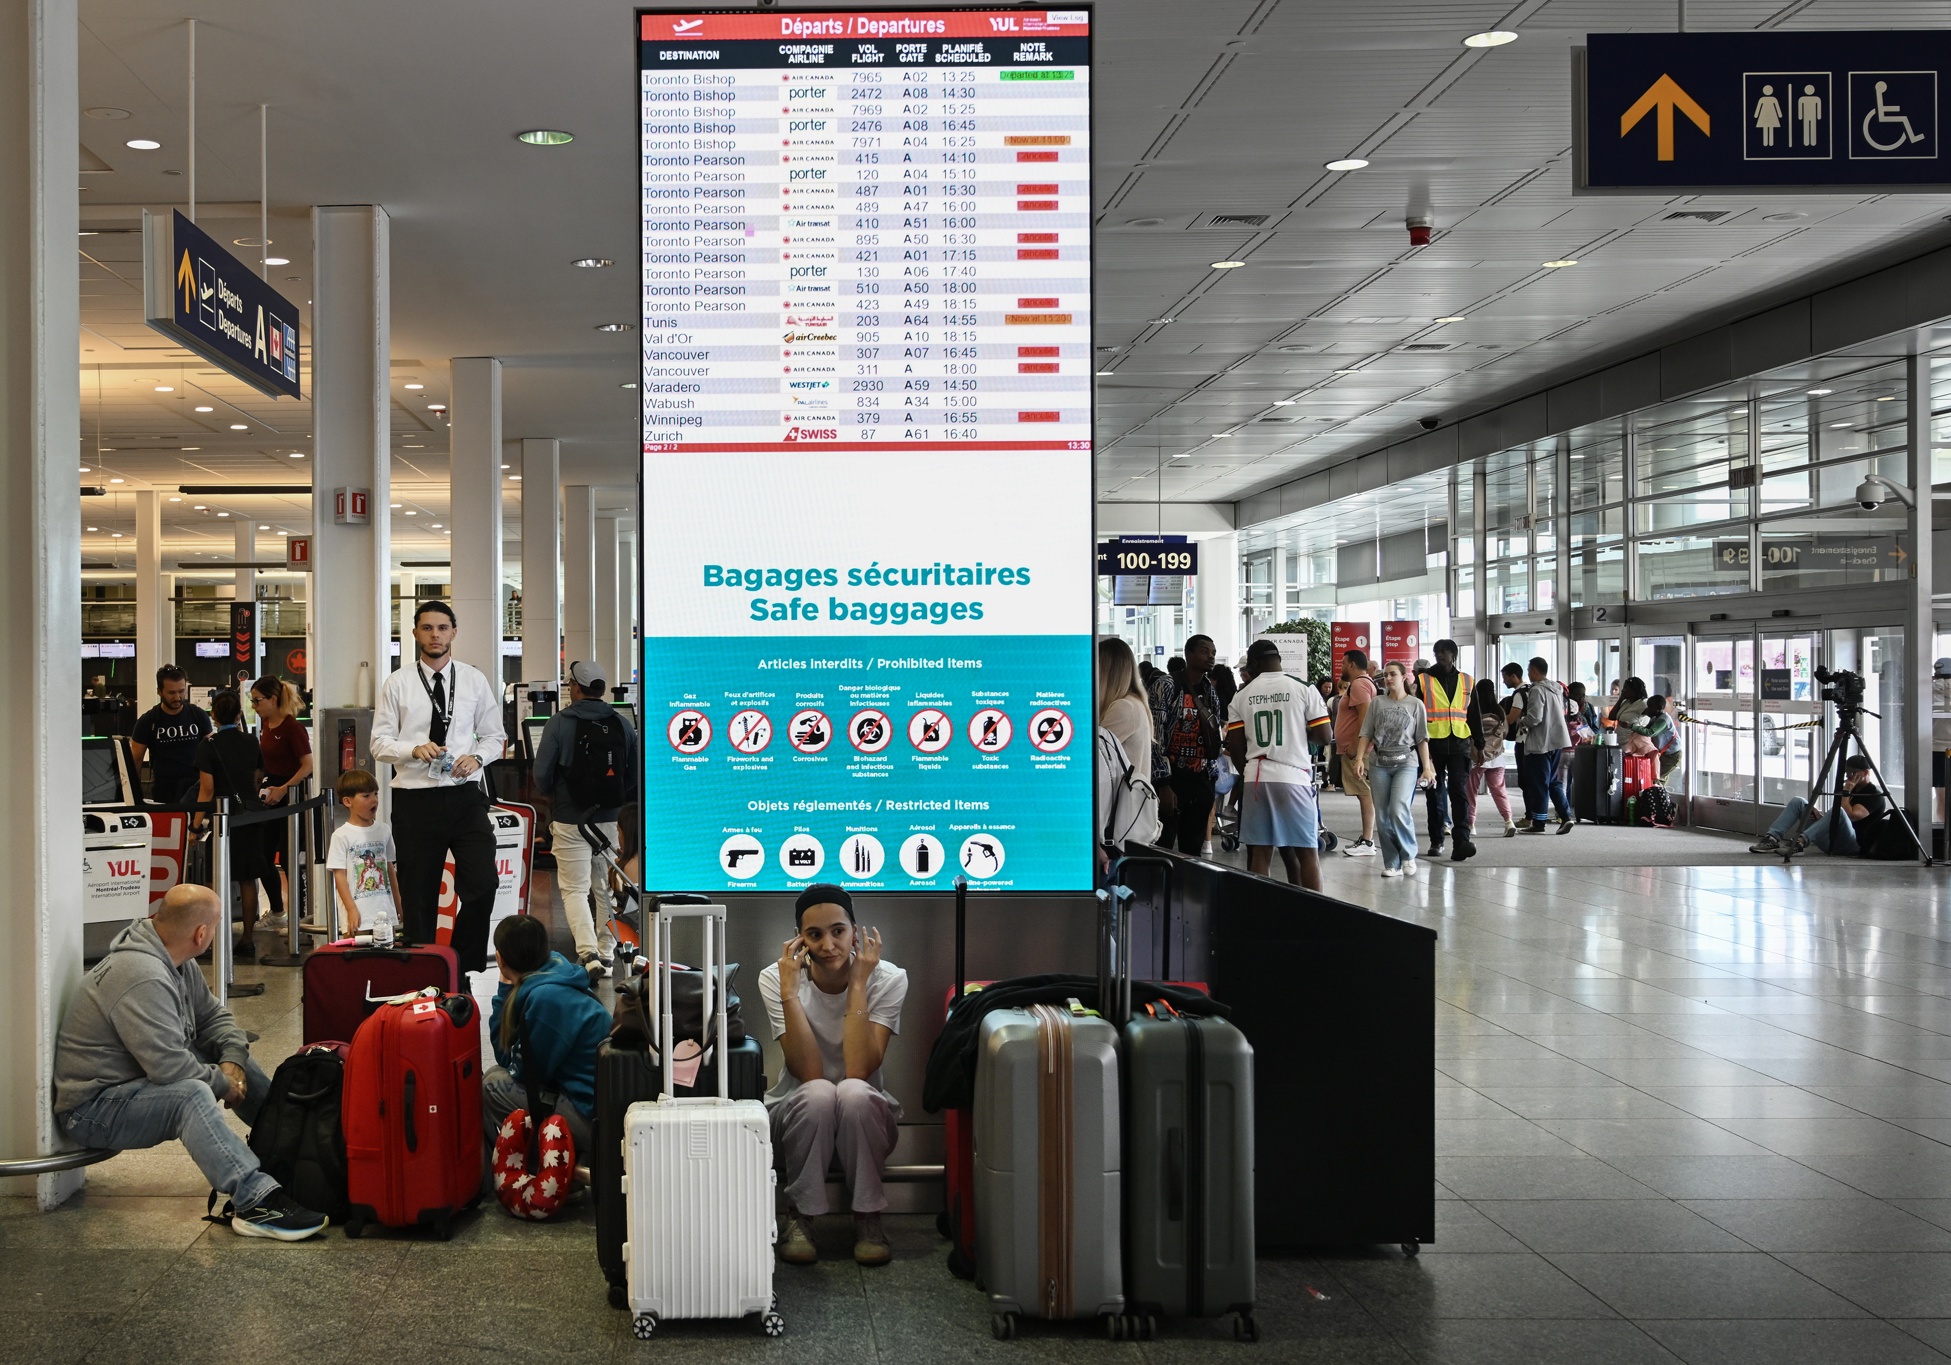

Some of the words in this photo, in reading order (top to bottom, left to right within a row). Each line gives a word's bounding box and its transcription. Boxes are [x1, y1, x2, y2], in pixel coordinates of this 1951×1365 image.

[781, 18, 843, 38] Départs
[847, 18, 853, 34] /
[857, 17, 945, 38] Departures
[990, 18, 1019, 31] YUL
[779, 45, 834, 55] COMPAGNIE
[858, 44, 878, 53] VOL
[896, 44, 927, 53] PORTE
[942, 42, 983, 53] PLANIFIÉ
[1020, 43, 1046, 52] NOTE
[659, 51, 719, 61] DESTINATION
[788, 54, 824, 63] AIRLINE
[852, 54, 884, 63] FLIGHT
[899, 53, 924, 63] GATE
[935, 53, 991, 63] SCHEDULED
[1013, 52, 1053, 62] REMARK
[644, 75, 689, 84] Toronto
[694, 75, 735, 87] Bishop
[853, 73, 882, 82] 7965
[943, 72, 975, 81] 13:25
[644, 91, 689, 101] Toronto
[694, 90, 735, 103] Bishop
[789, 86, 826, 100] porter
[852, 89, 881, 99] 2472
[944, 88, 975, 98] 14:30
[644, 220, 689, 230] Toronto
[695, 220, 745, 230] Pearson
[856, 218, 878, 228] 410
[944, 218, 976, 228] 16:00
[218, 278, 243, 314] Départs
[645, 318, 677, 328] Tunis
[857, 316, 879, 326] 203
[945, 315, 976, 325] 14:55
[218, 309, 252, 349] Departures
[255, 304, 268, 365] A
[645, 334, 662, 343] Val
[667, 334, 691, 343] d'Or
[796, 333, 837, 341] airCreebec
[857, 332, 879, 342] 905
[944, 331, 976, 341] 18:15
[645, 350, 708, 360] Vancouver
[857, 348, 879, 358] 307
[944, 348, 976, 358] 16:45
[645, 383, 700, 392] Varadero
[790, 382, 821, 390] WESTJET
[853, 381, 883, 391] 2930
[944, 380, 976, 390] 14:50
[645, 415, 702, 426] Winnipeg
[858, 413, 879, 423] 379
[905, 413, 912, 421] A
[946, 413, 977, 423] 16:55
[645, 431, 683, 441] Zurich
[800, 429, 837, 439] SWISS
[862, 429, 875, 439] 87
[945, 429, 977, 439] 16:40
[1117, 552, 1191, 569] 100-199
[703, 564, 838, 591] Bagages
[847, 561, 1030, 587] sécuritaires
[749, 596, 819, 622] Safe
[829, 596, 984, 625] baggages
[1596, 608, 1607, 621] 2
[758, 659, 806, 669] Articles
[866, 658, 874, 670] /
[878, 658, 943, 668] Prohibited
[156, 723, 199, 739] POLO
[1254, 709, 1283, 747] 01
[748, 800, 789, 812] Objets
[793, 800, 872, 812] réglementés
[875, 799, 882, 812] /
[886, 800, 950, 810] Restricted
[107, 860, 141, 877] YUL
[96, 885, 140, 893] Montréal-Trudeau
